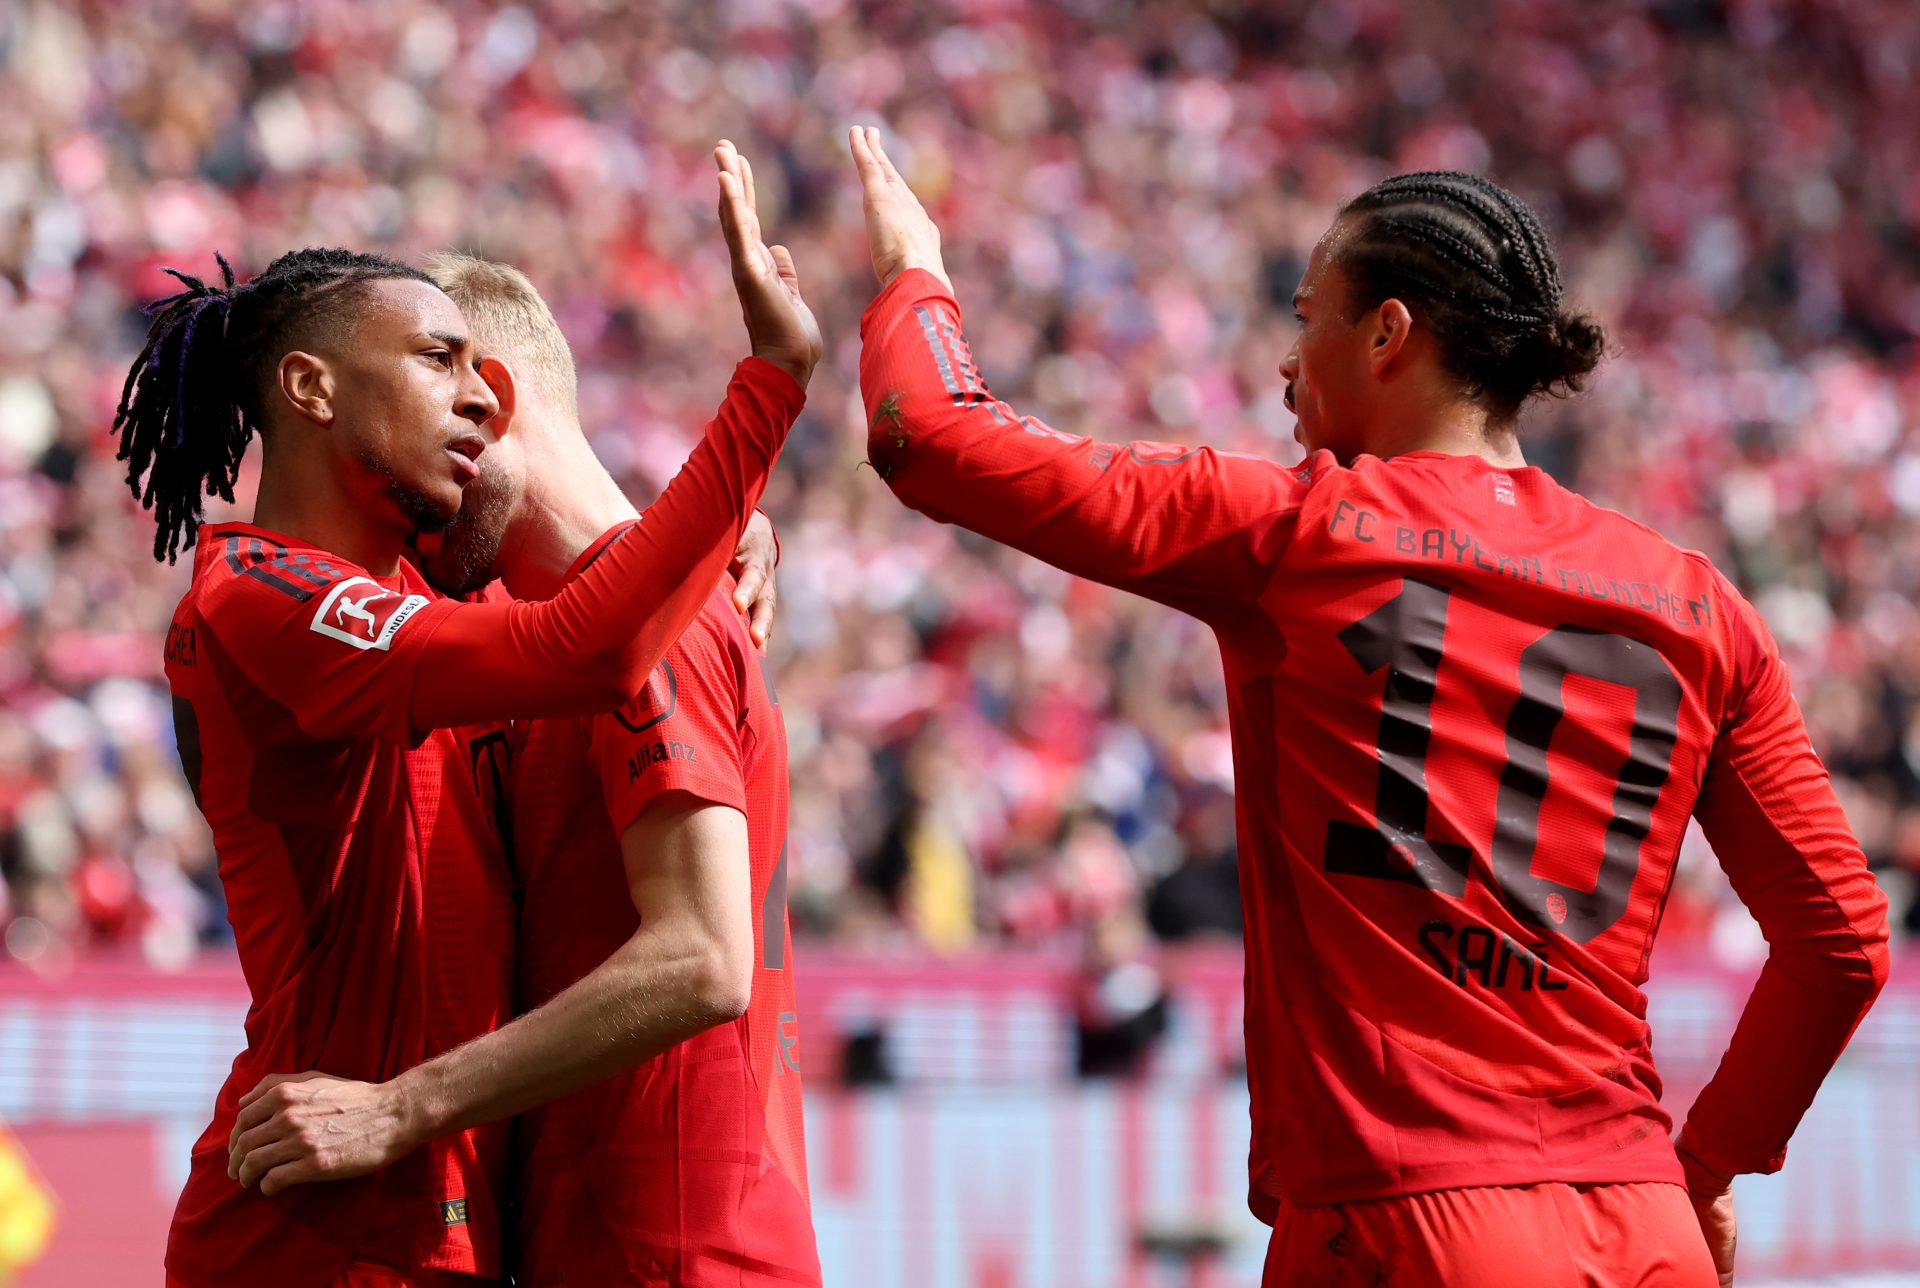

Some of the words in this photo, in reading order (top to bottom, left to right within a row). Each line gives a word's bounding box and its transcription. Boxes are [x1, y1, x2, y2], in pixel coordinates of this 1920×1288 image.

[1329, 499, 1377, 542] FC
[1396, 527, 1543, 584] BAYERN
[627, 740, 697, 785] Allianz
[1324, 575, 1684, 944] 10
[1418, 920, 1569, 991] SANÉ
